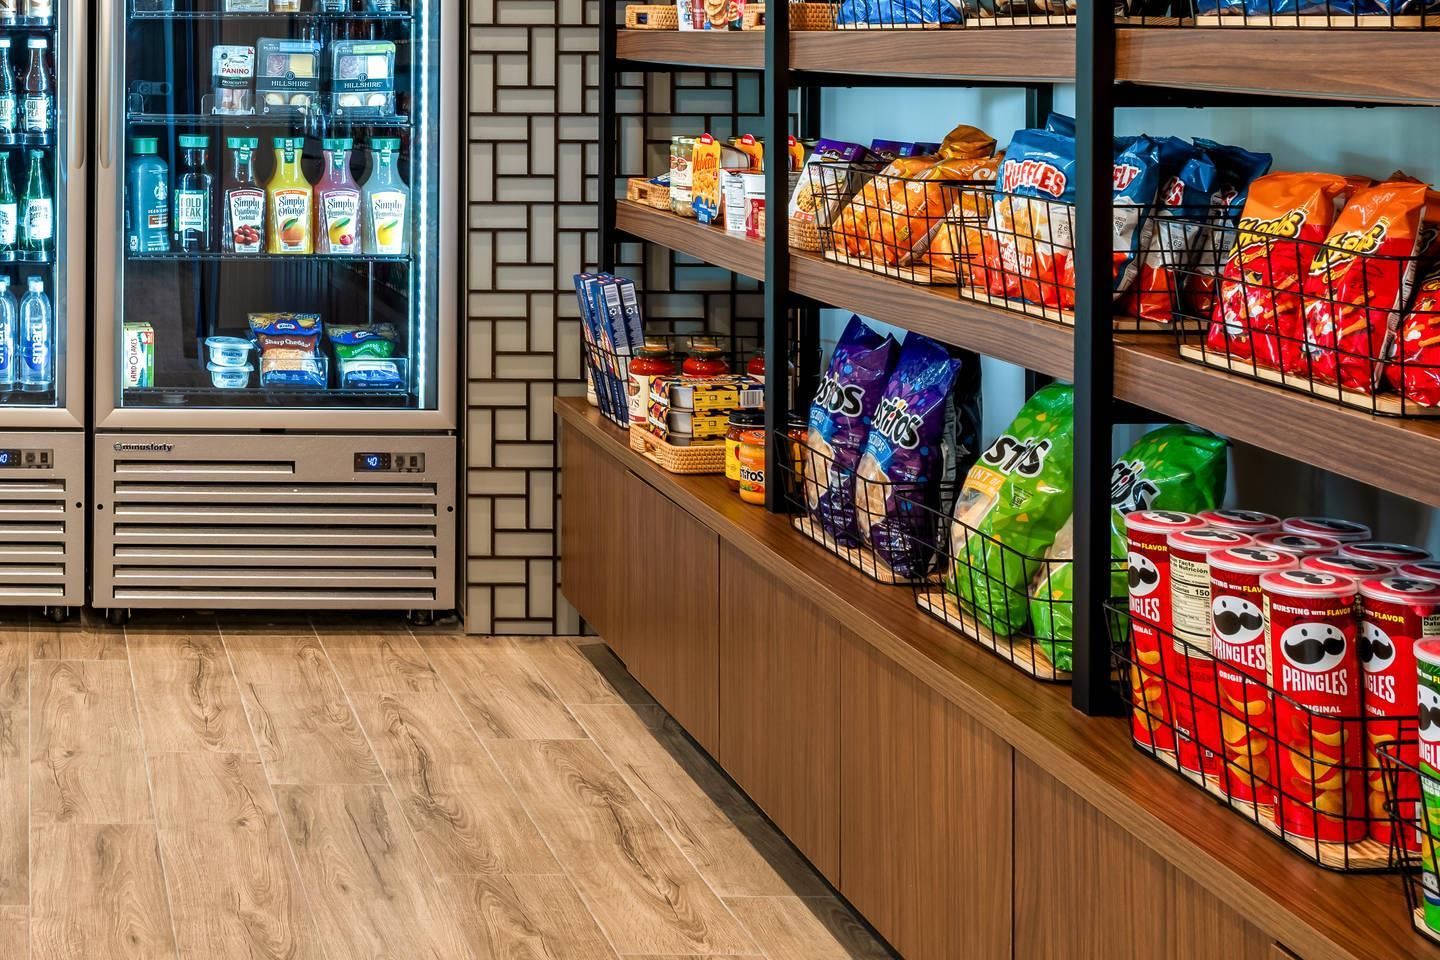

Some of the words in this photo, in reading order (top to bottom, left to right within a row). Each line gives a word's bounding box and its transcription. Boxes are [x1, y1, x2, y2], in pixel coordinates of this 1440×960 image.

[271, 80, 309, 88] HILLSHIRE
[344, 81, 382, 89] HILLSHIRE
[1002, 159, 1067, 198] RUFFLES
[278, 197, 305, 208] Simply
[327, 199, 355, 210] Simply
[264, 338, 284, 346] Sharp
[367, 456, 378, 467] 40
[1141, 542, 1168, 552] FLAVOR
[1195, 589, 1210, 597] 150
[1242, 585, 1263, 594] FLAV
[1272, 603, 1310, 616] BURSTING
[1311, 609, 1326, 617] WITH
[1374, 611, 1405, 624] FLAVOR
[1213, 634, 1266, 671] PRINGLES
[1282, 663, 1348, 697] PRINGLES
